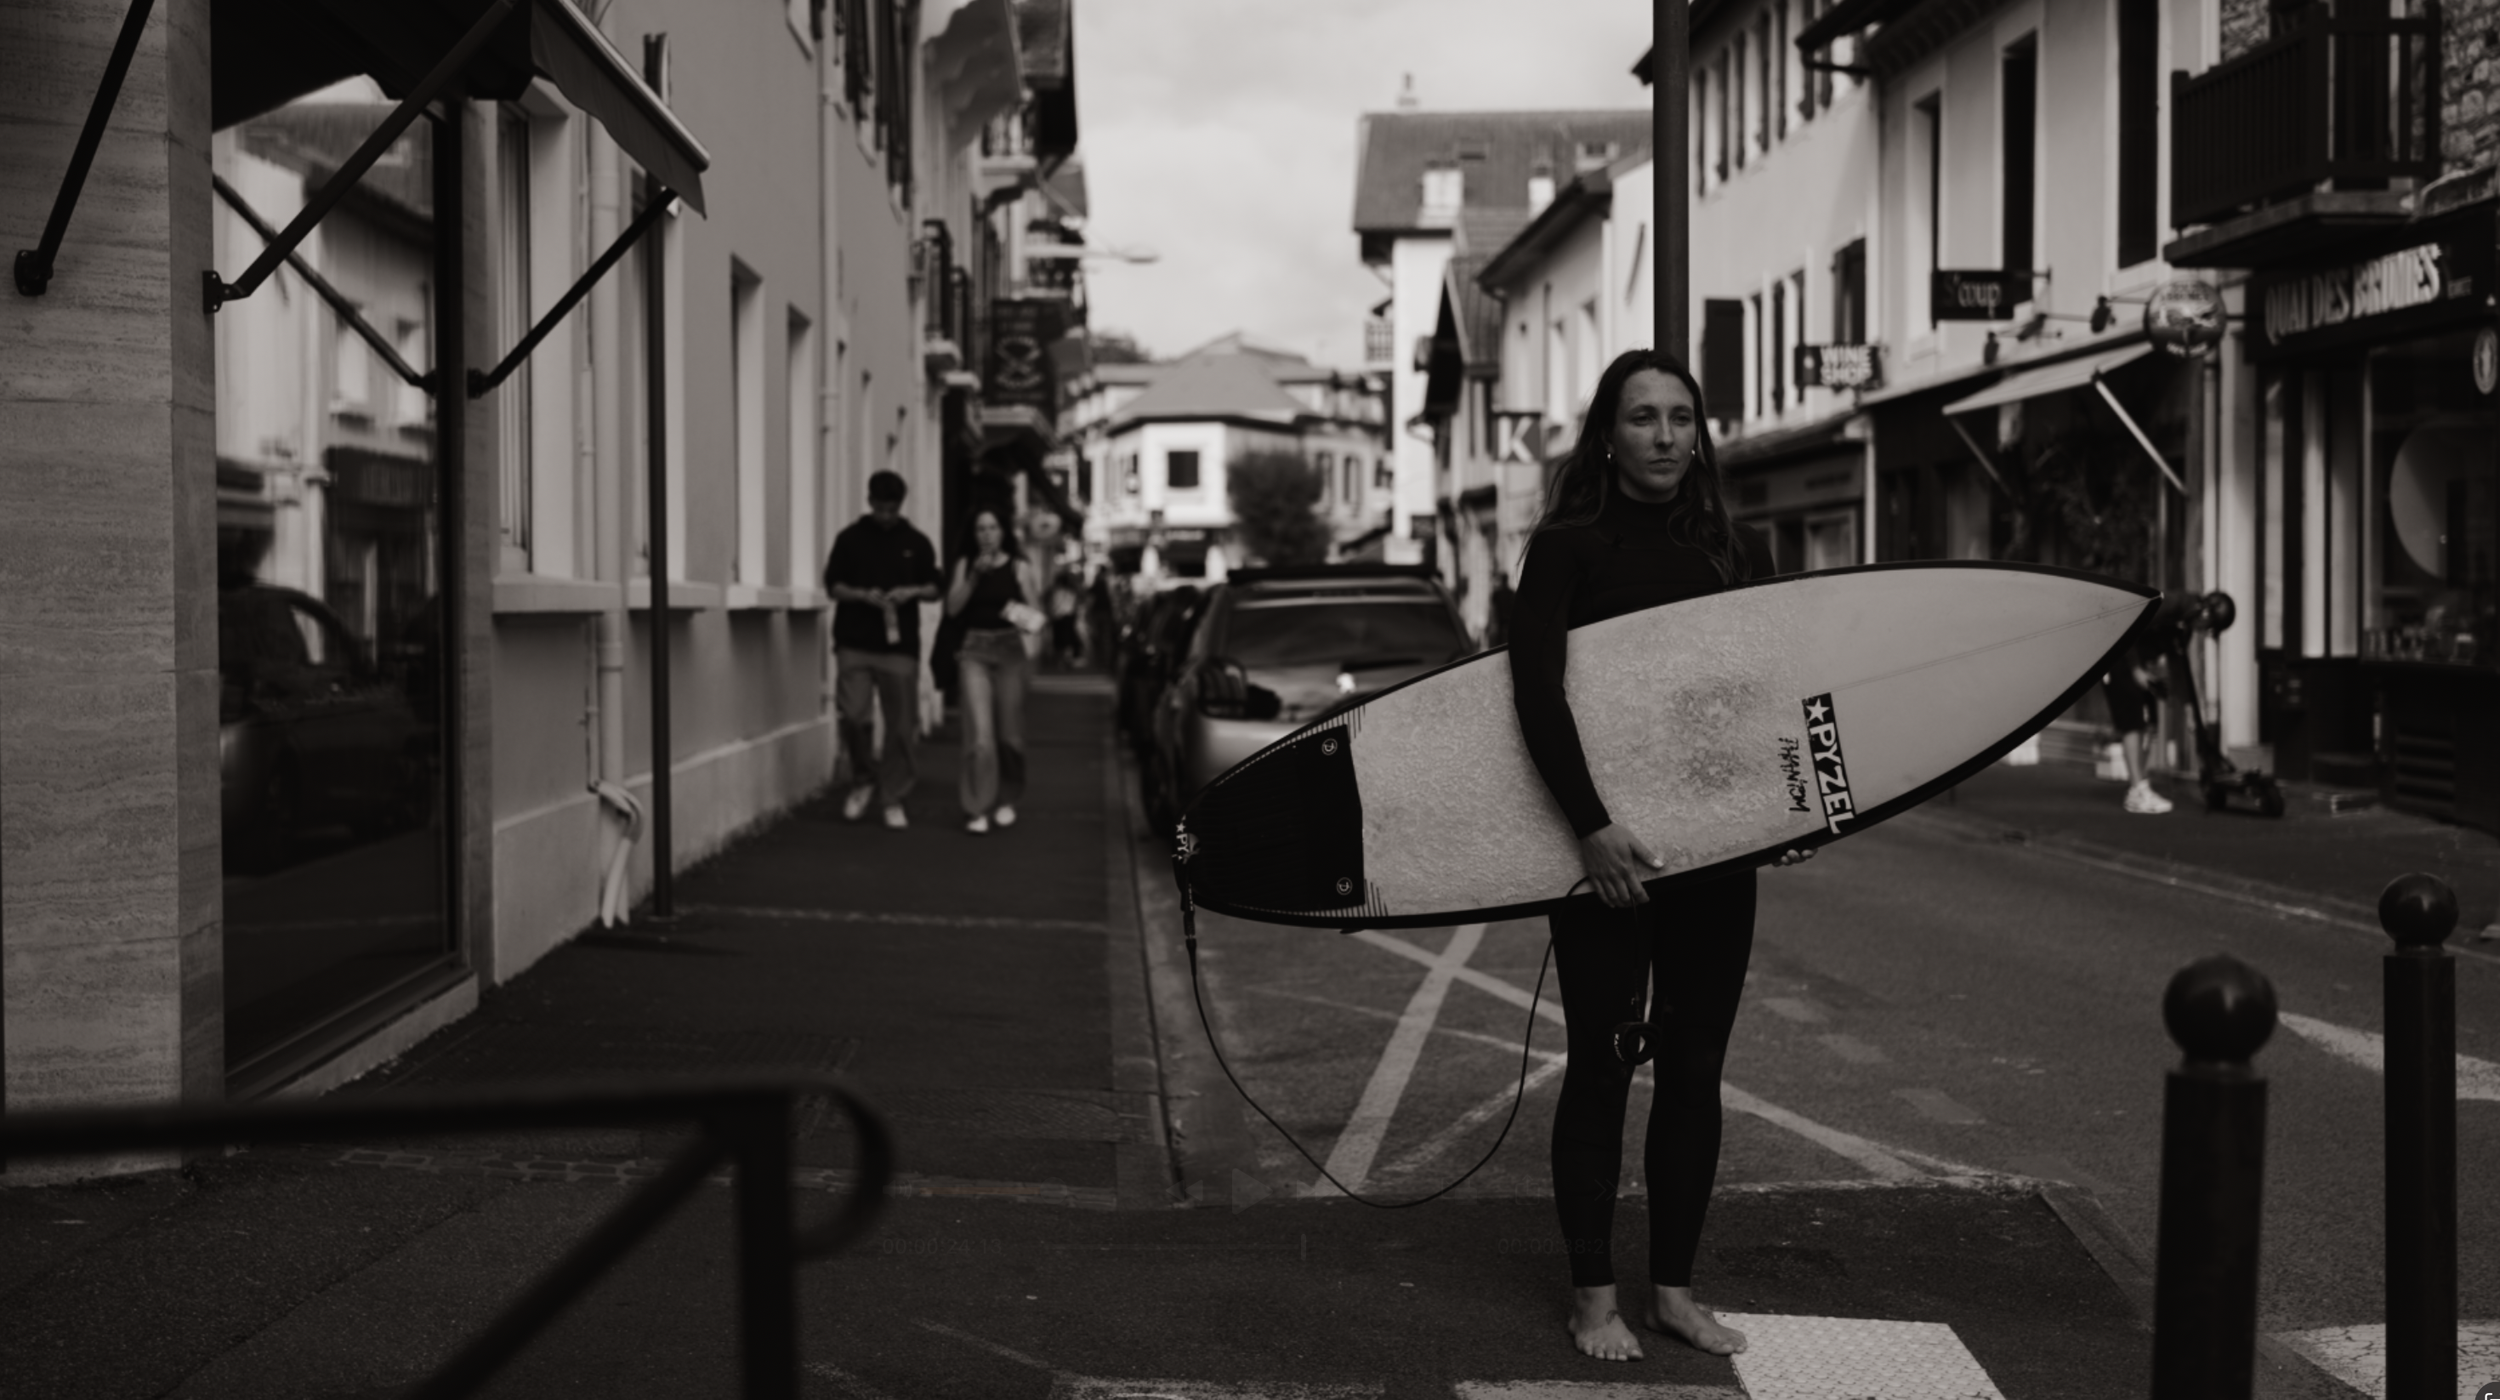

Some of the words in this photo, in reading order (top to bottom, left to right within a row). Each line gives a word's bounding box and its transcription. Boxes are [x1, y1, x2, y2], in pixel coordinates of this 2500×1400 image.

[2265, 276, 2309, 346] QUAI
[2312, 267, 2350, 329] DES
[1821, 345, 1871, 367] WINE
[1821, 366, 1872, 387] SHOP
[1809, 722, 1856, 834] PYZEL
